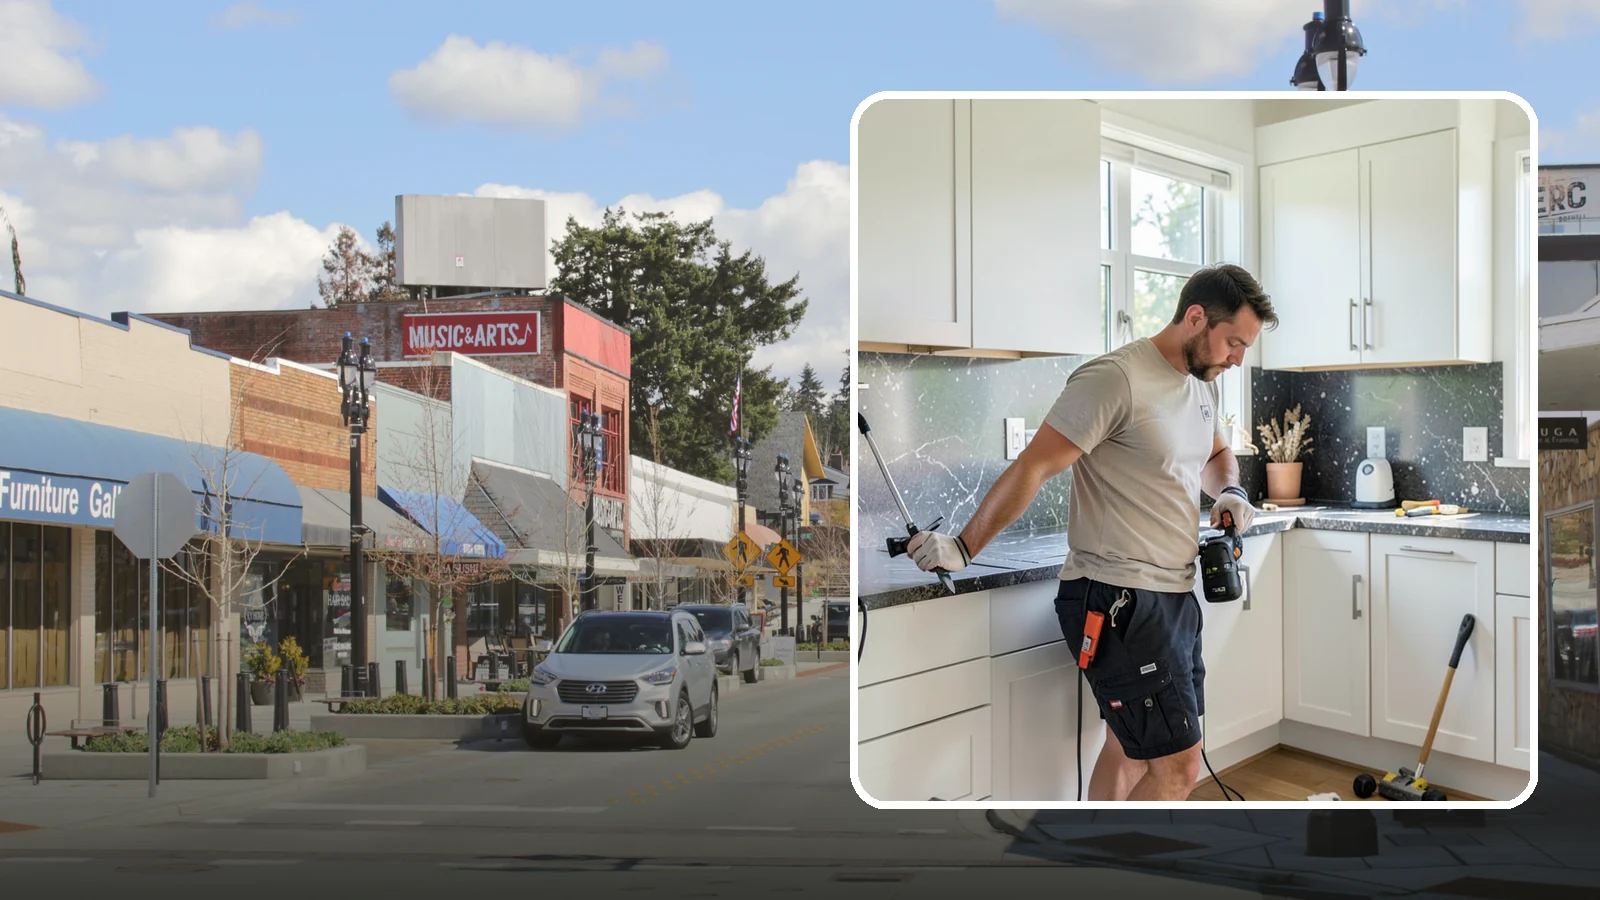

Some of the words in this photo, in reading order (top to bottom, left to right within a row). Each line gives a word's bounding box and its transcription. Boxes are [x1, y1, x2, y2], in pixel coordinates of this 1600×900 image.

[409, 323, 519, 349] MUSIC&ARTS
[1540, 428, 1577, 436] UGA
[0, 471, 79, 515] Furniture
[89, 482, 121, 519] Gal
[453, 563, 479, 574] SUSHI
